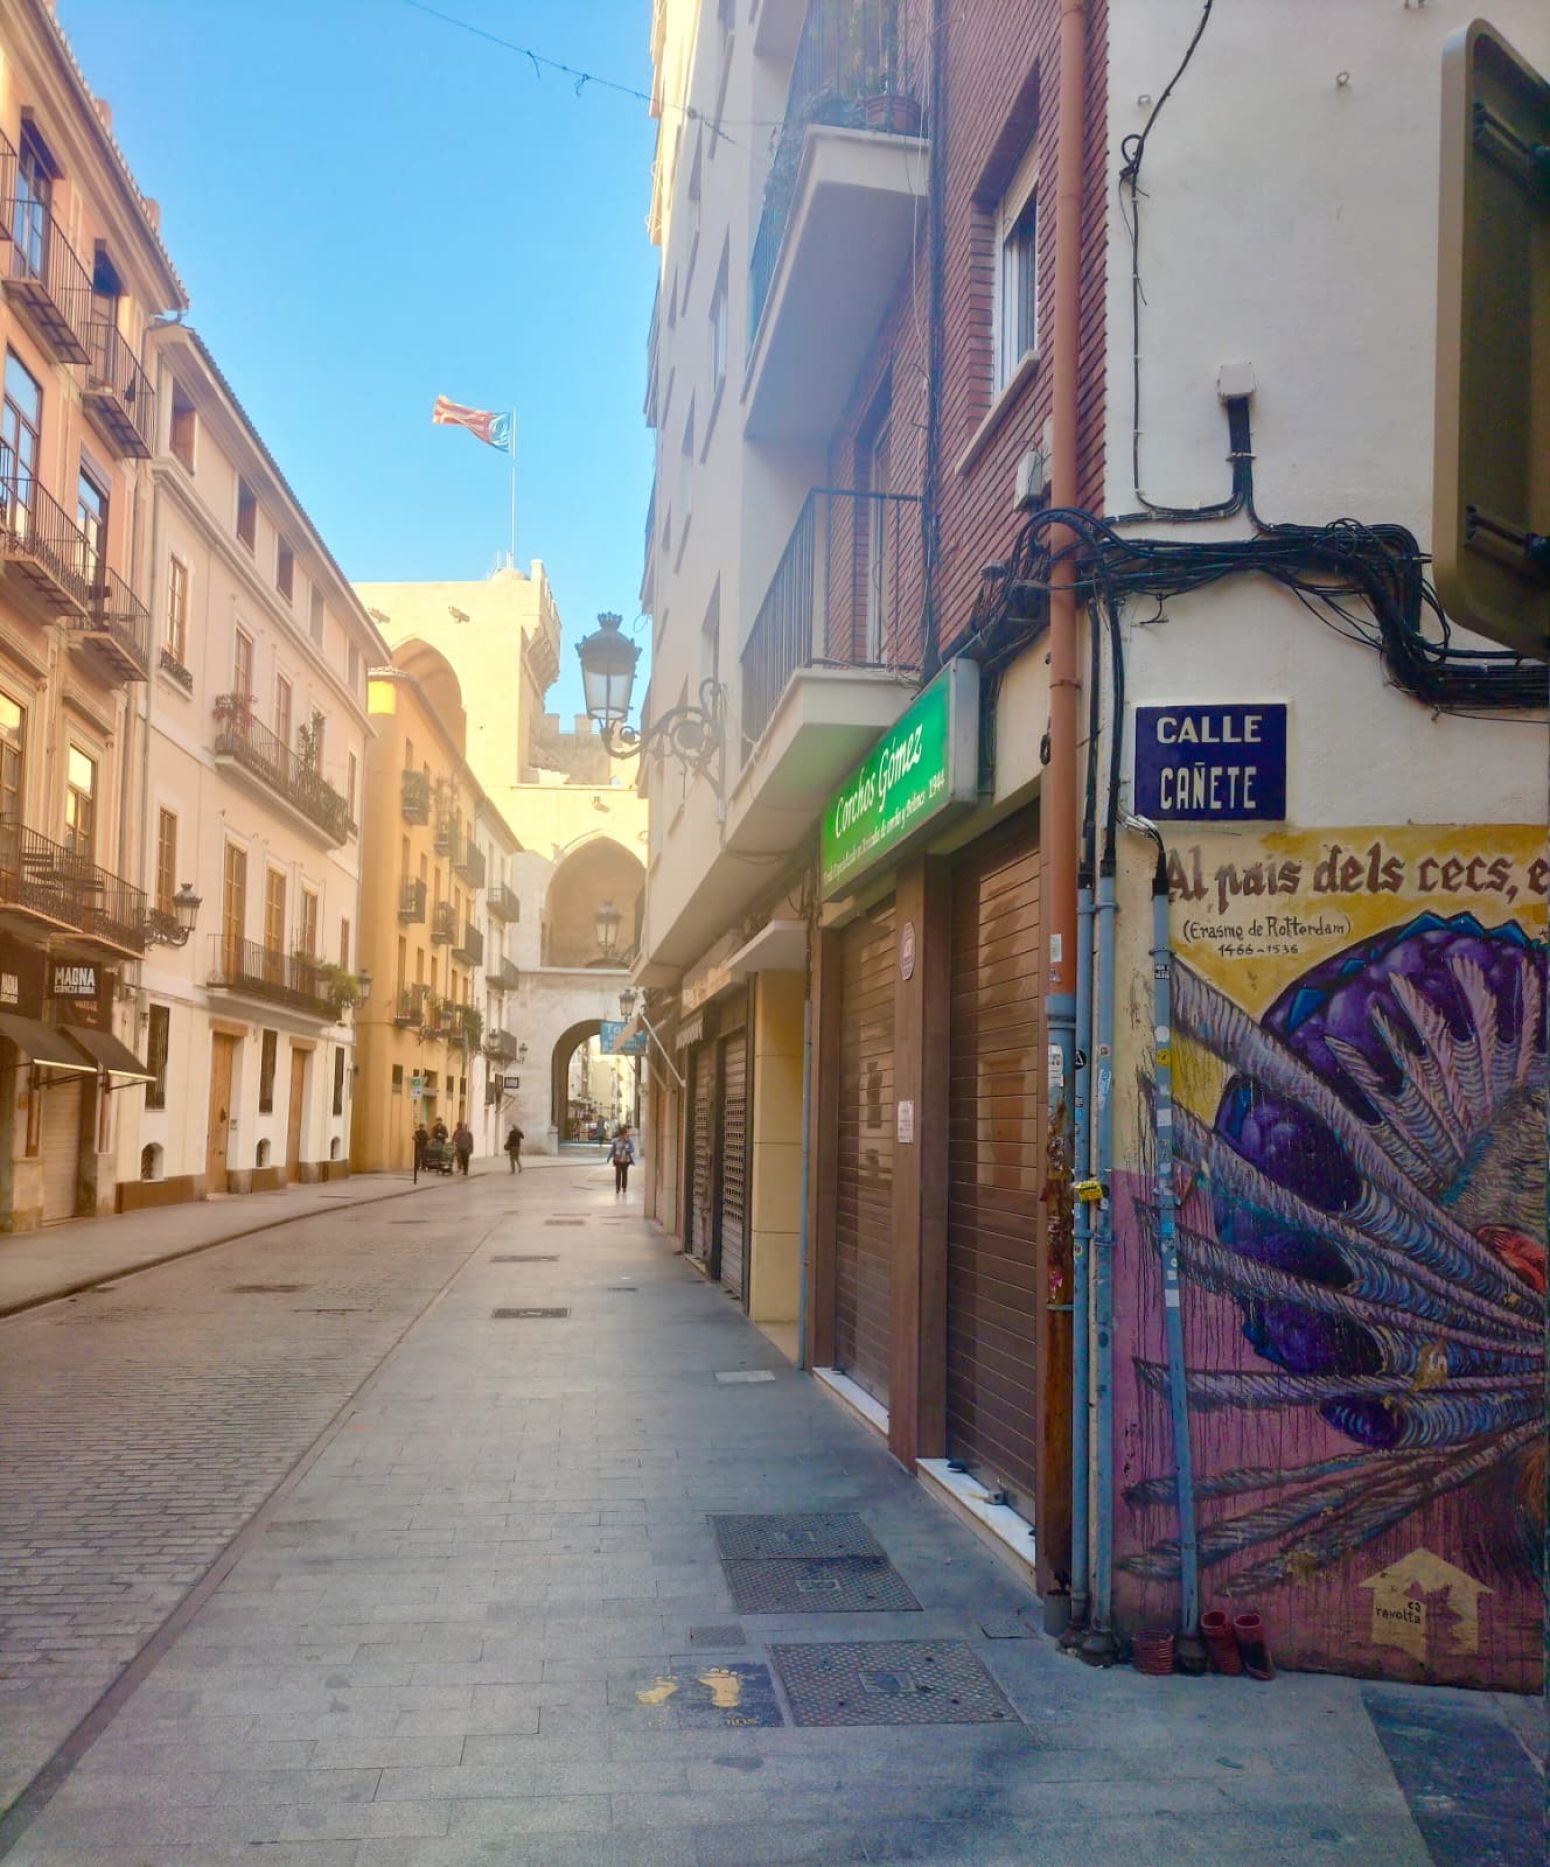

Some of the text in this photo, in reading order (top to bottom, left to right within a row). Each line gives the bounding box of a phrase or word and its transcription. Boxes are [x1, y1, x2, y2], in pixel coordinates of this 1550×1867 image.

[1156, 714, 1263, 744] CALLE
[878, 722, 923, 814] Gómez
[1159, 761, 1258, 811] CAÑETE
[1165, 845, 1210, 902] Al
[1312, 840, 1406, 894] dels
[1417, 855, 1519, 905] cecs,
[1248, 919, 1264, 937] de
[1265, 915, 1351, 938] Rotterdam)
[54, 966, 96, 987] MAGNA
[1376, 1607, 1422, 1625] revolta
